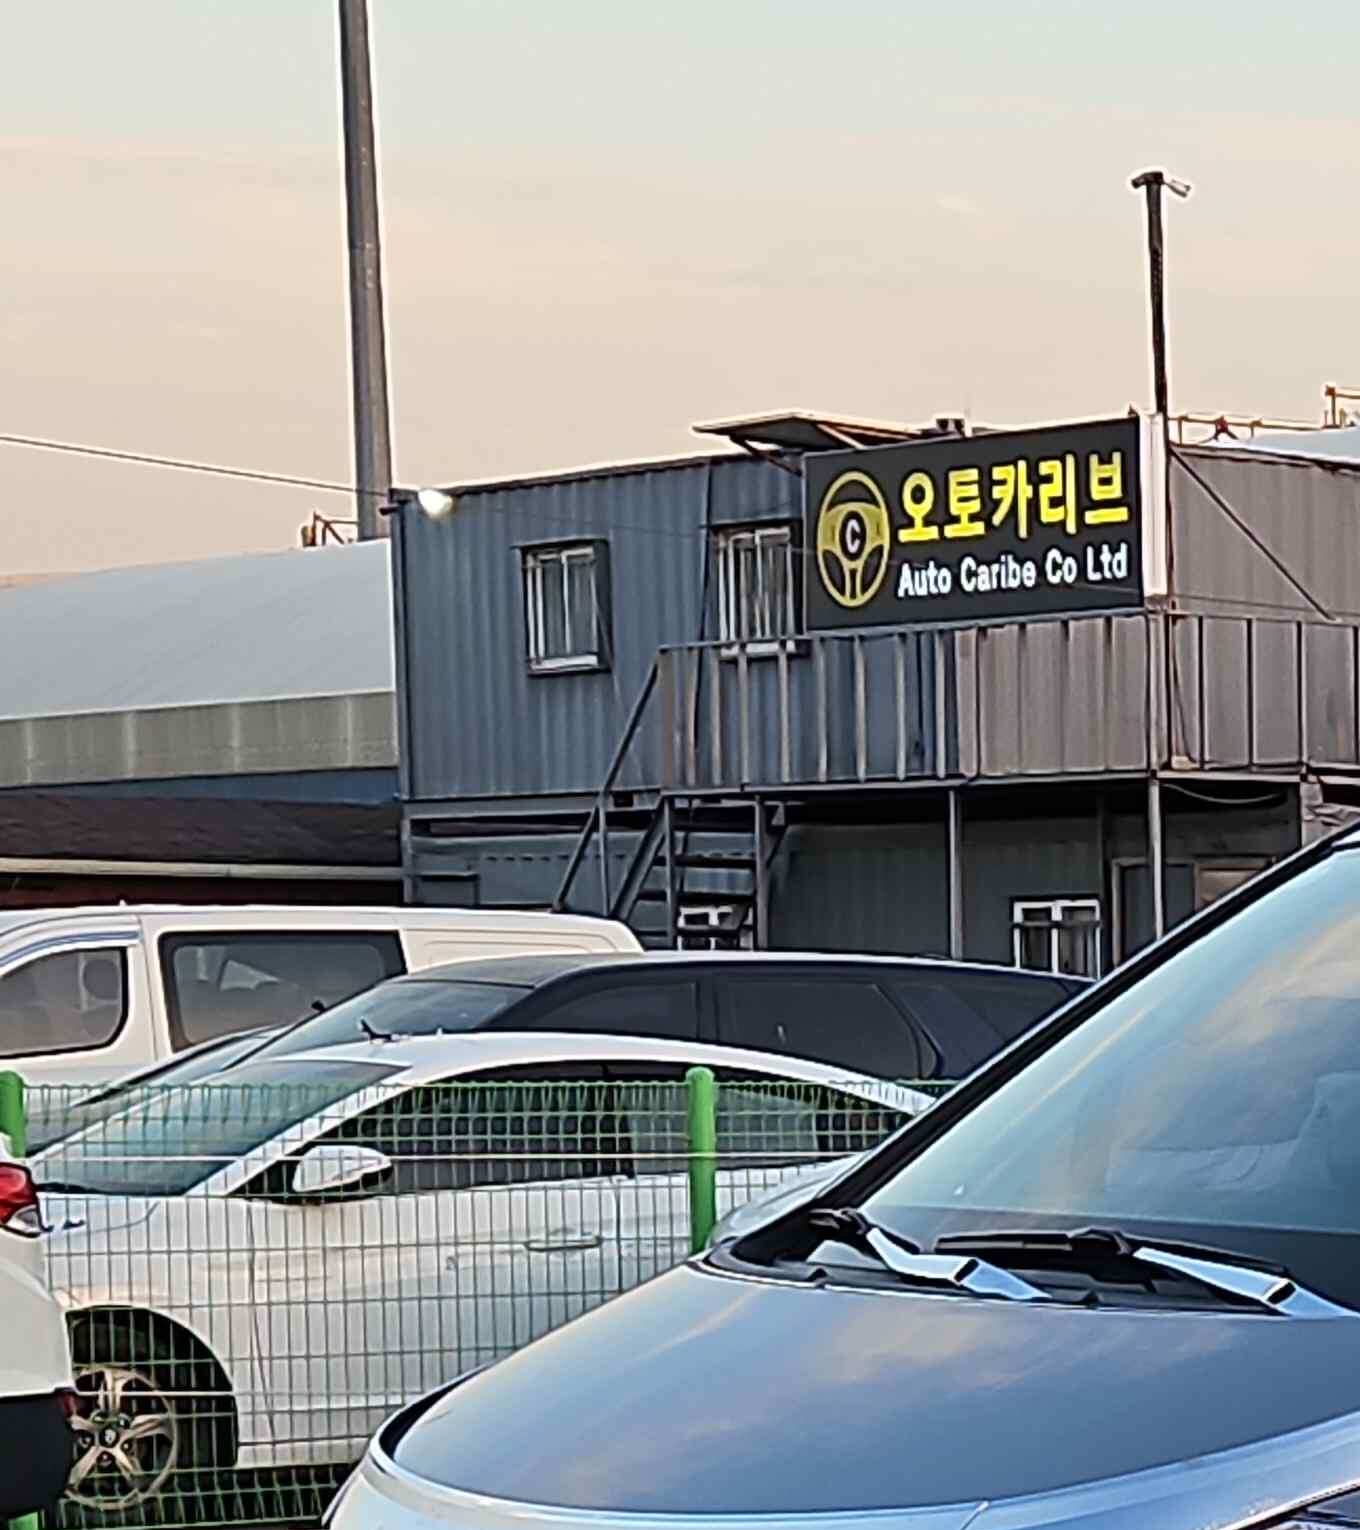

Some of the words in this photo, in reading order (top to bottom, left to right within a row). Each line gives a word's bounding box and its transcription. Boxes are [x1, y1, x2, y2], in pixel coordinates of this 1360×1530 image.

[897, 451, 1130, 543] 오토카리브
[845, 519, 861, 553] C
[898, 560, 952, 598] Auto
[959, 554, 1037, 592] Caribe
[1045, 548, 1078, 584] Co
[1086, 542, 1129, 579] Ltd
